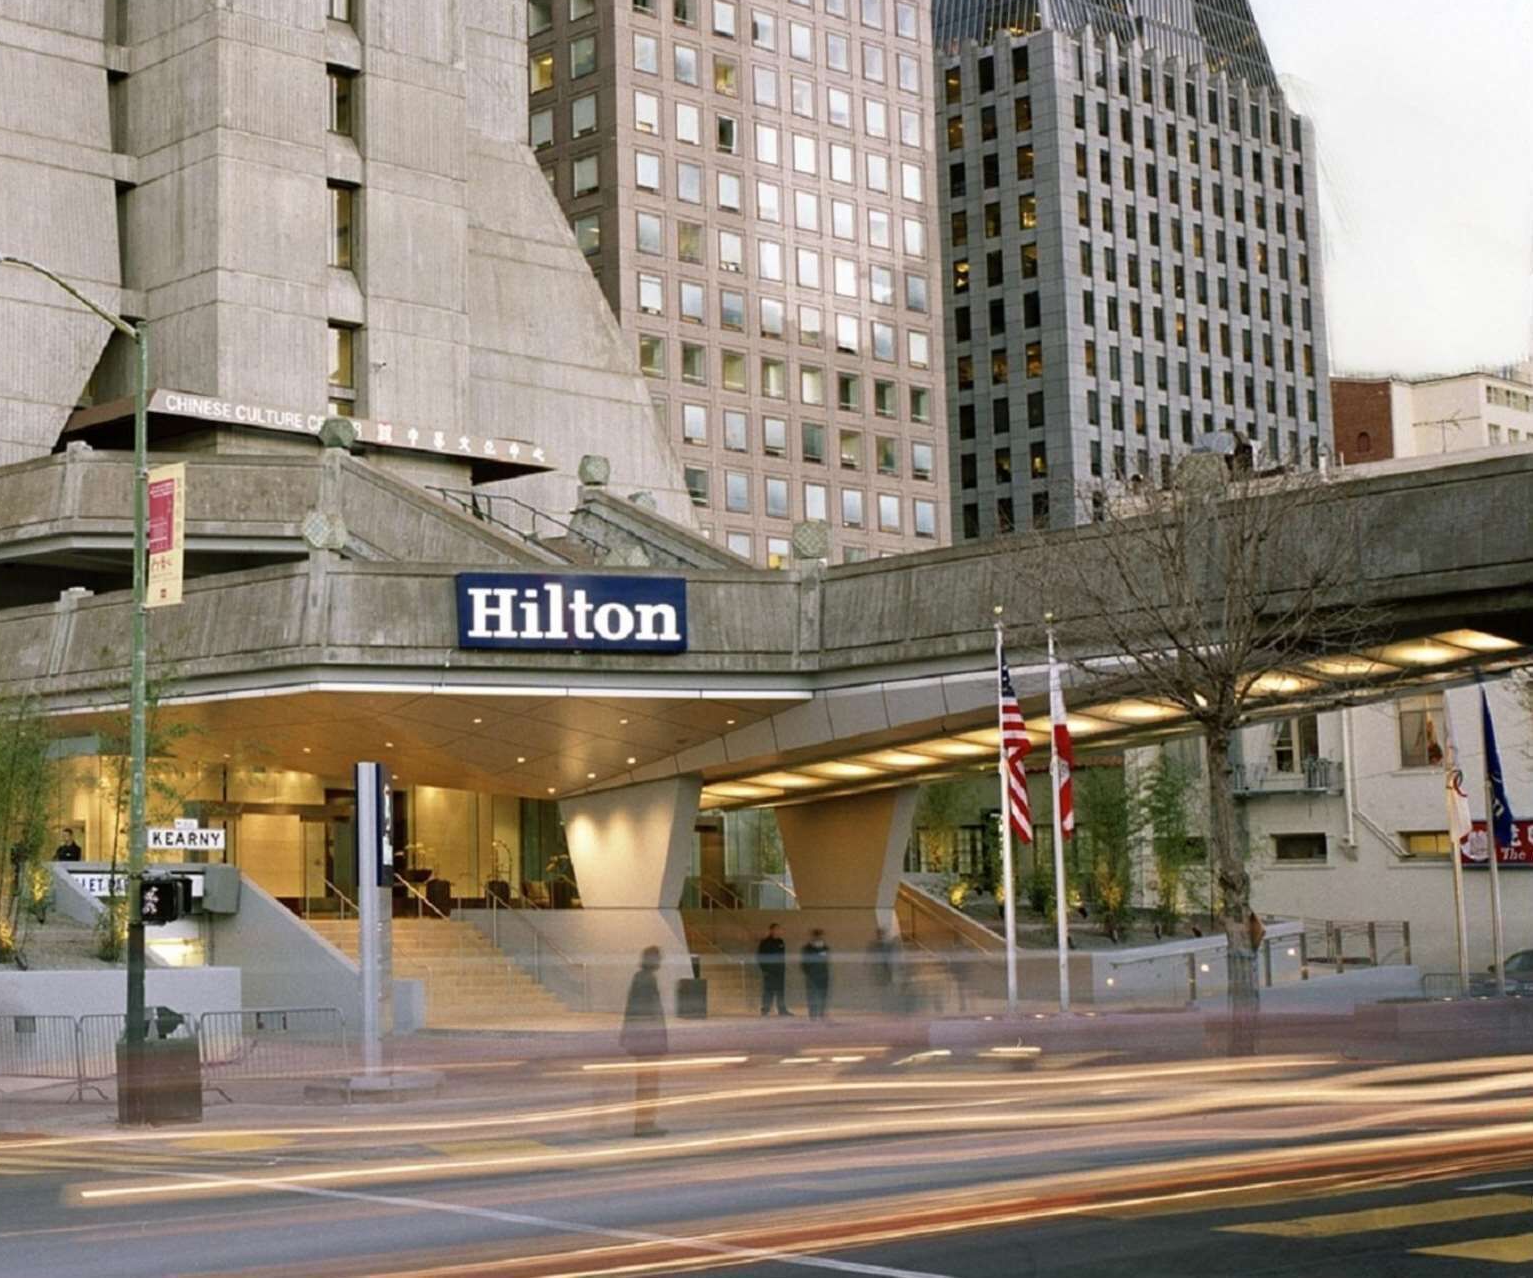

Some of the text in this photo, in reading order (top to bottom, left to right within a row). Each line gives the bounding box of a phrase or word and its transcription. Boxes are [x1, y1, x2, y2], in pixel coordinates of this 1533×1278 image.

[165, 395, 232, 418] CHINESE
[235, 405, 303, 429] CULTURE
[467, 582, 681, 641] Hilton
[152, 831, 221, 846] KEARNY
